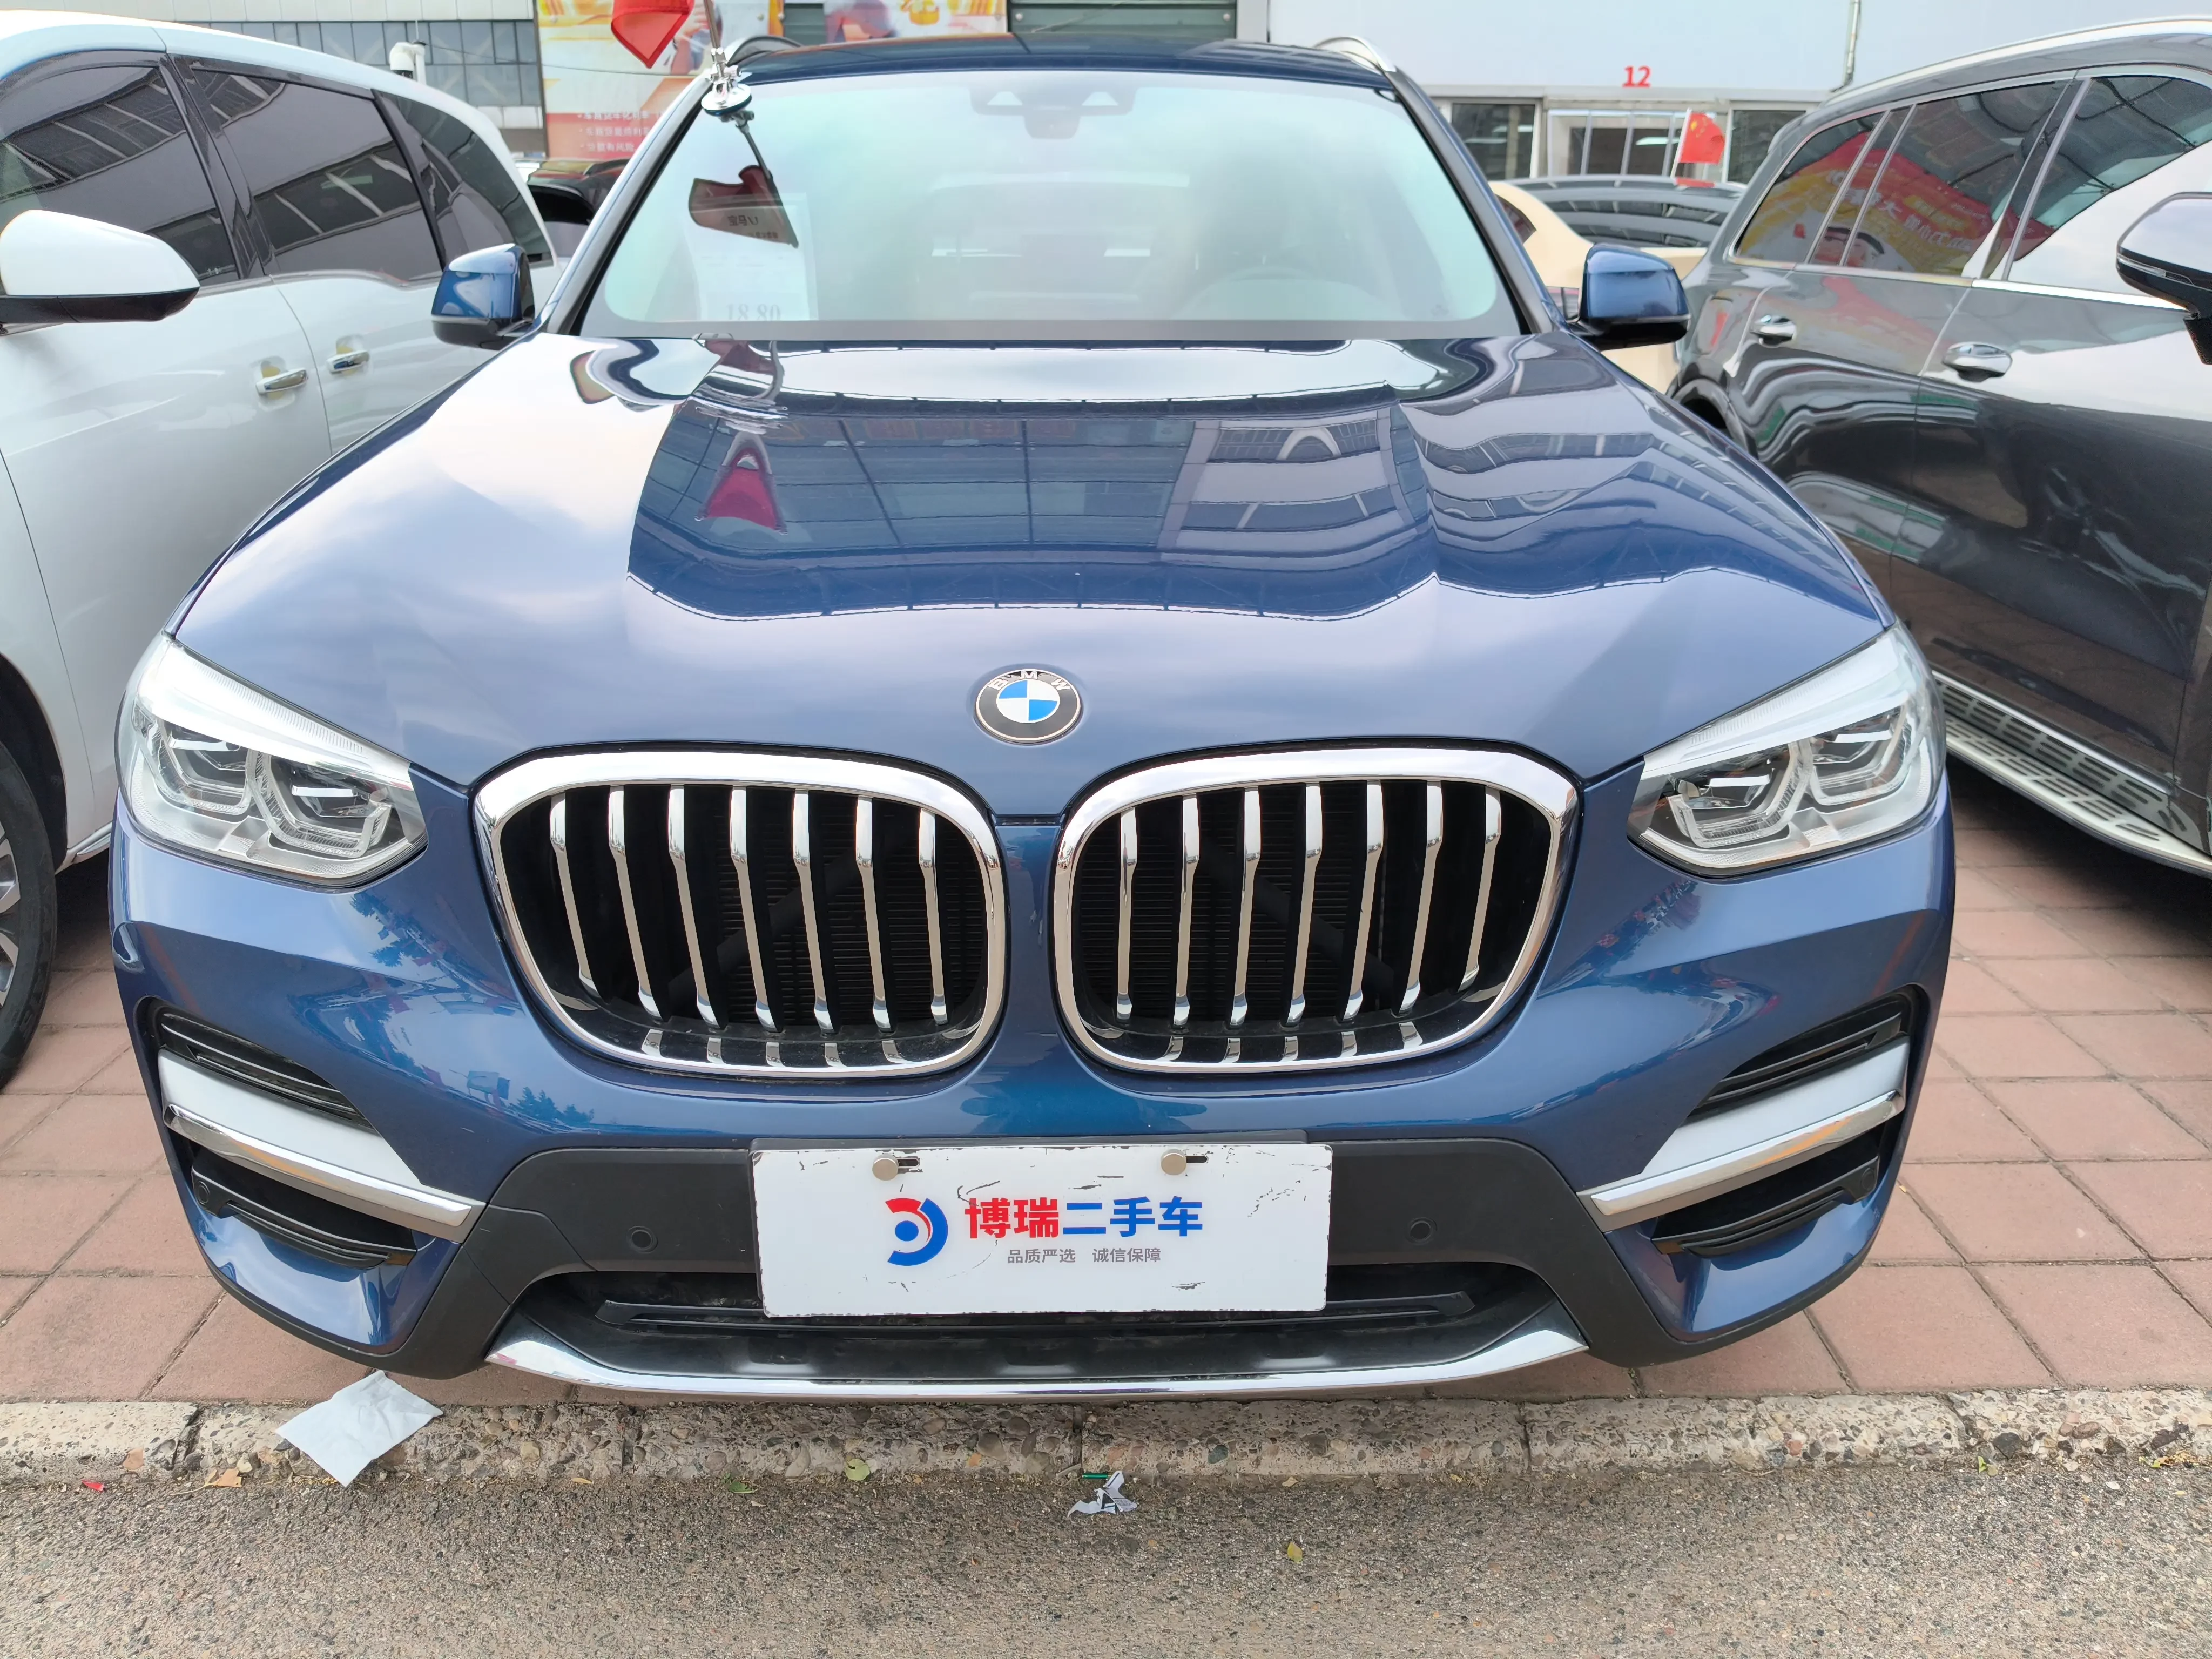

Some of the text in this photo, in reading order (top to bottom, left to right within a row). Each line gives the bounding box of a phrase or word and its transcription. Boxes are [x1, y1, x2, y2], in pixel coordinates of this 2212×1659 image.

[1622, 65, 1650, 87] 12
[988, 671, 1071, 690] BMW
[965, 1196, 1203, 1239] 博瑞二手车
[1007, 1248, 1161, 1263] 品质严选 诚信保障
